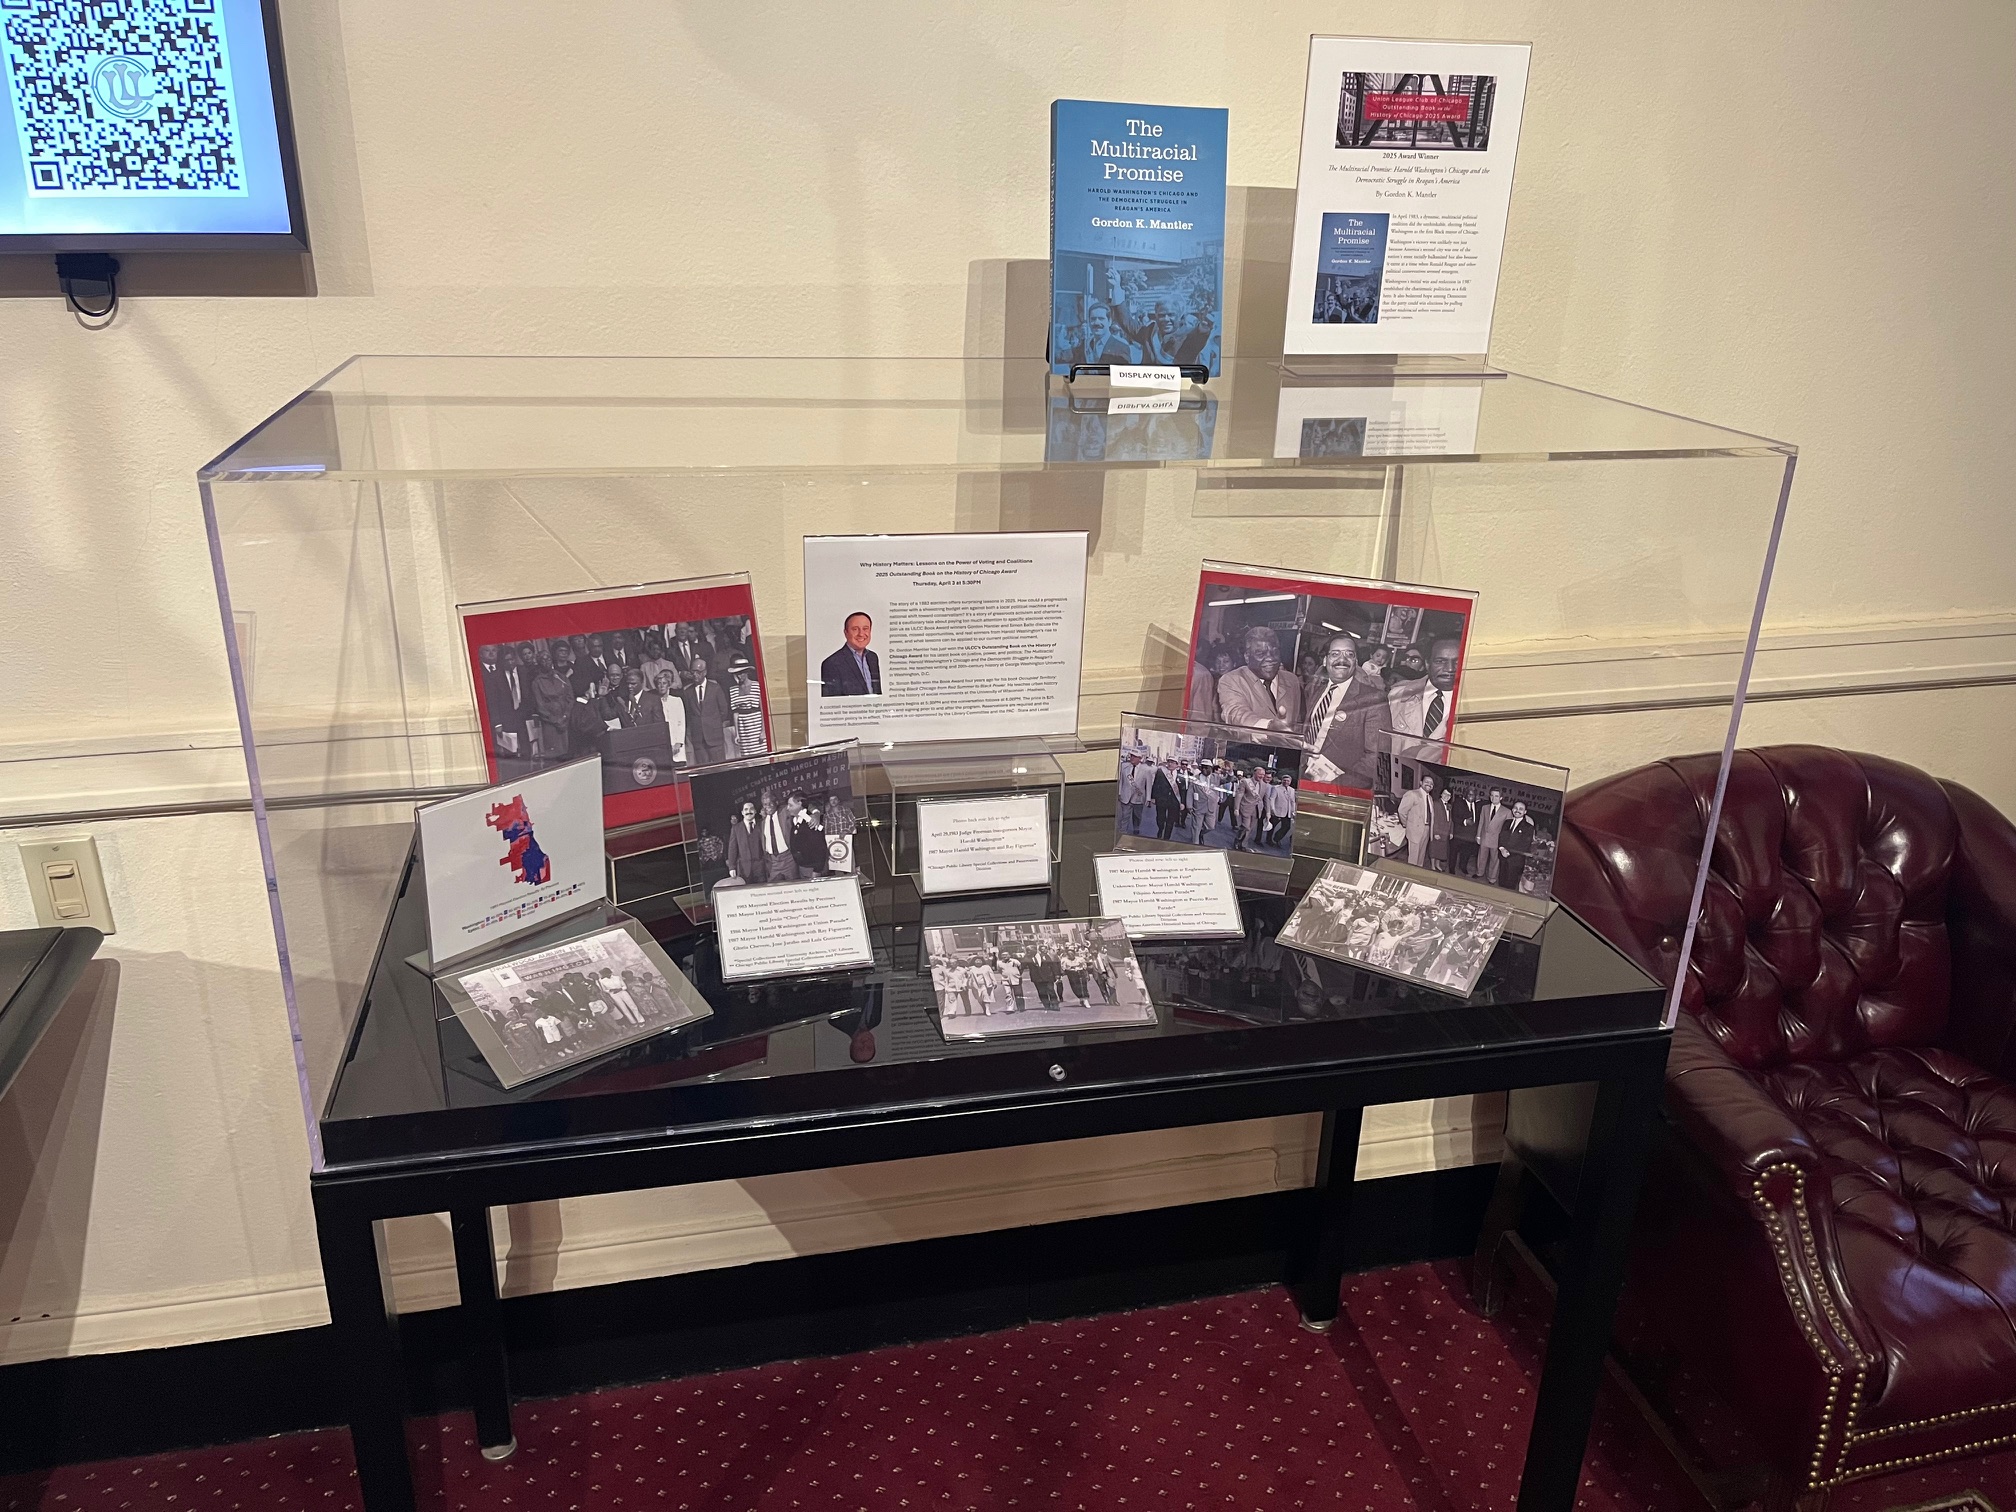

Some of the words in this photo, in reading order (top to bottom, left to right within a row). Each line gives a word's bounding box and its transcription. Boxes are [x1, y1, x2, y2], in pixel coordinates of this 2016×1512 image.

[1127, 120, 1162, 136] The
[1091, 141, 1197, 160] Multiracial
[1104, 163, 1183, 182] Promise
[1092, 218, 1133, 228] Gordon
[1136, 219, 1148, 229] K.
[1150, 220, 1193, 230] Mantler
[775, 769, 788, 778] AND
[791, 758, 819, 773] HAROLD
[760, 779, 788, 794] UNITED
[794, 771, 818, 783] FARM
[812, 778, 839, 790] WARD
